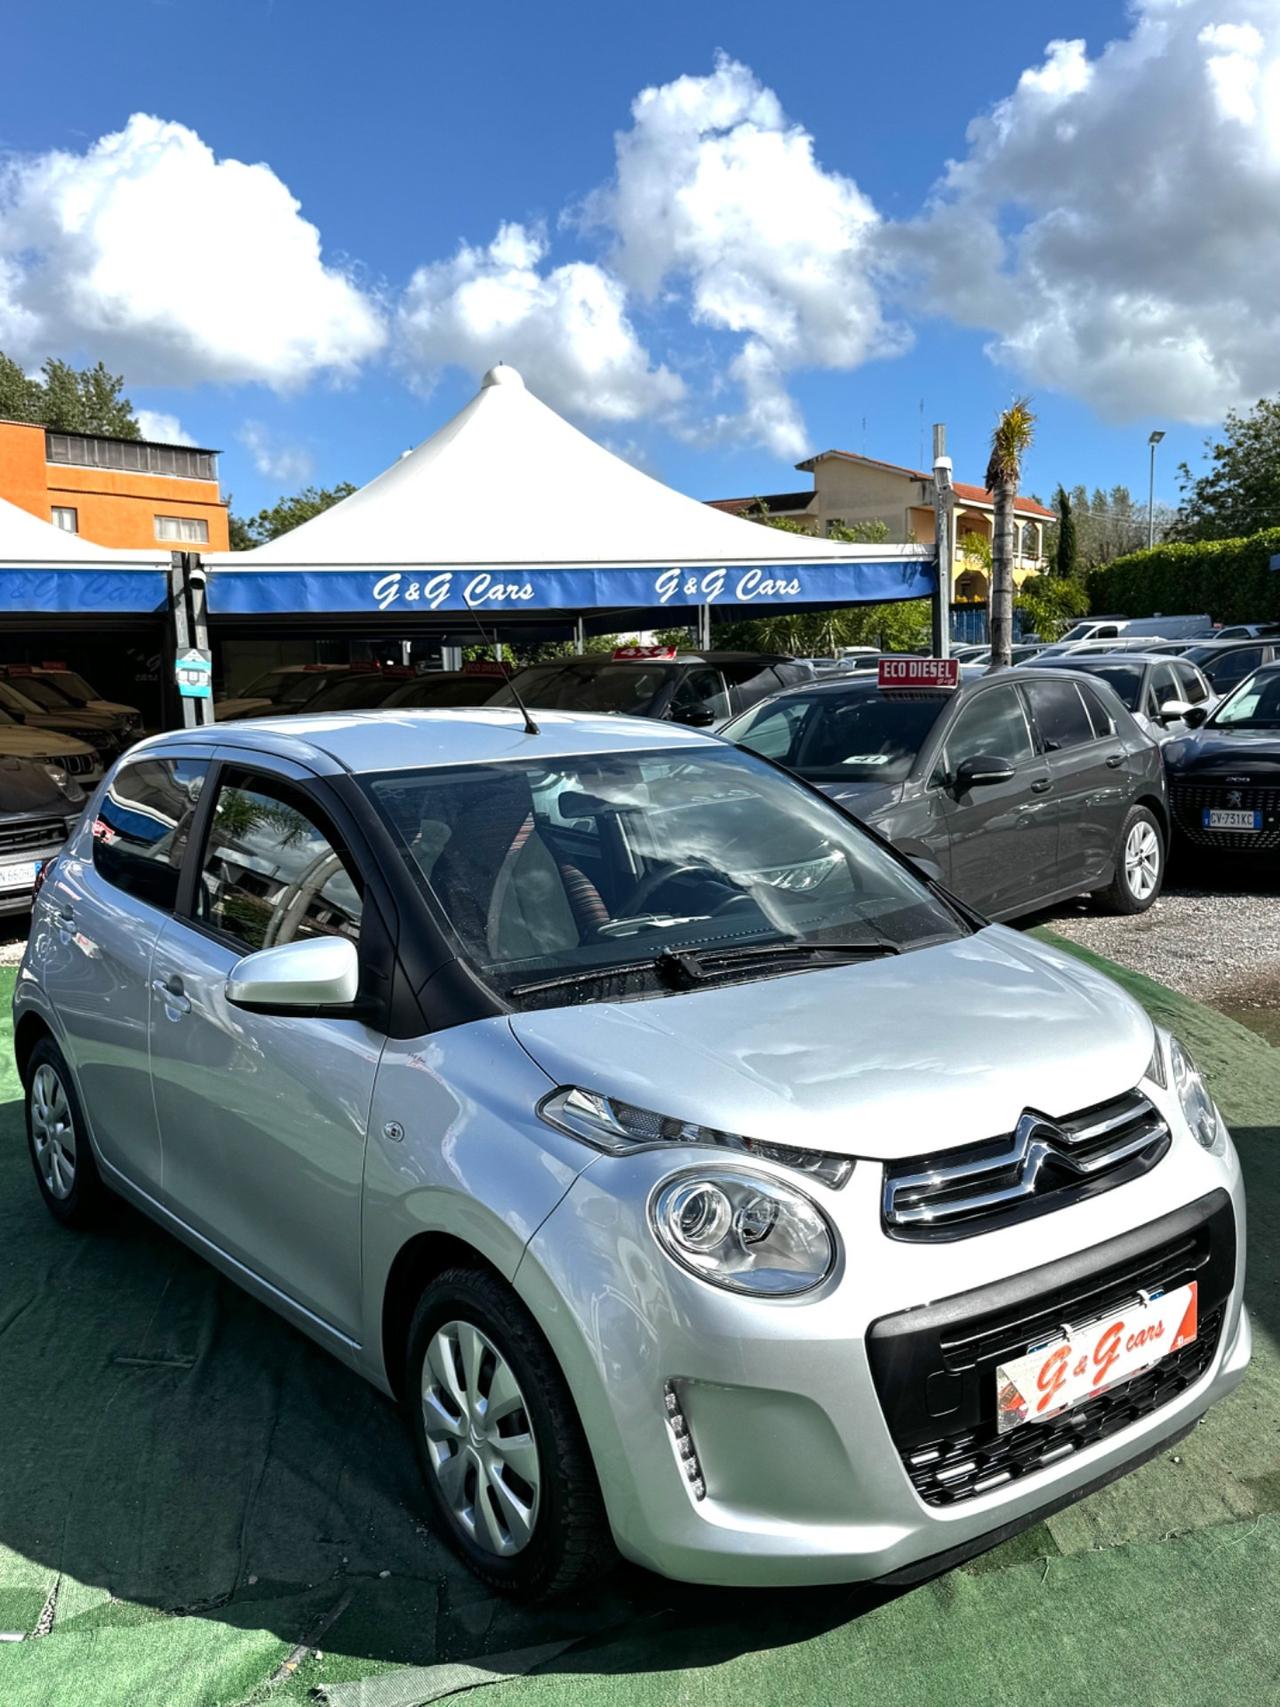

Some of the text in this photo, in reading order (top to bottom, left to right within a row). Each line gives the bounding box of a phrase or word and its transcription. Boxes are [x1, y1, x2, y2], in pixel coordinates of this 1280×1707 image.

[463, 573, 535, 606] Cars
[736, 569, 801, 601] Cars
[883, 661, 952, 678] ECO DIESEL
[1036, 1345, 1072, 1413] G
[1092, 1321, 1125, 1387] G
[1126, 1319, 1165, 1352] cars
